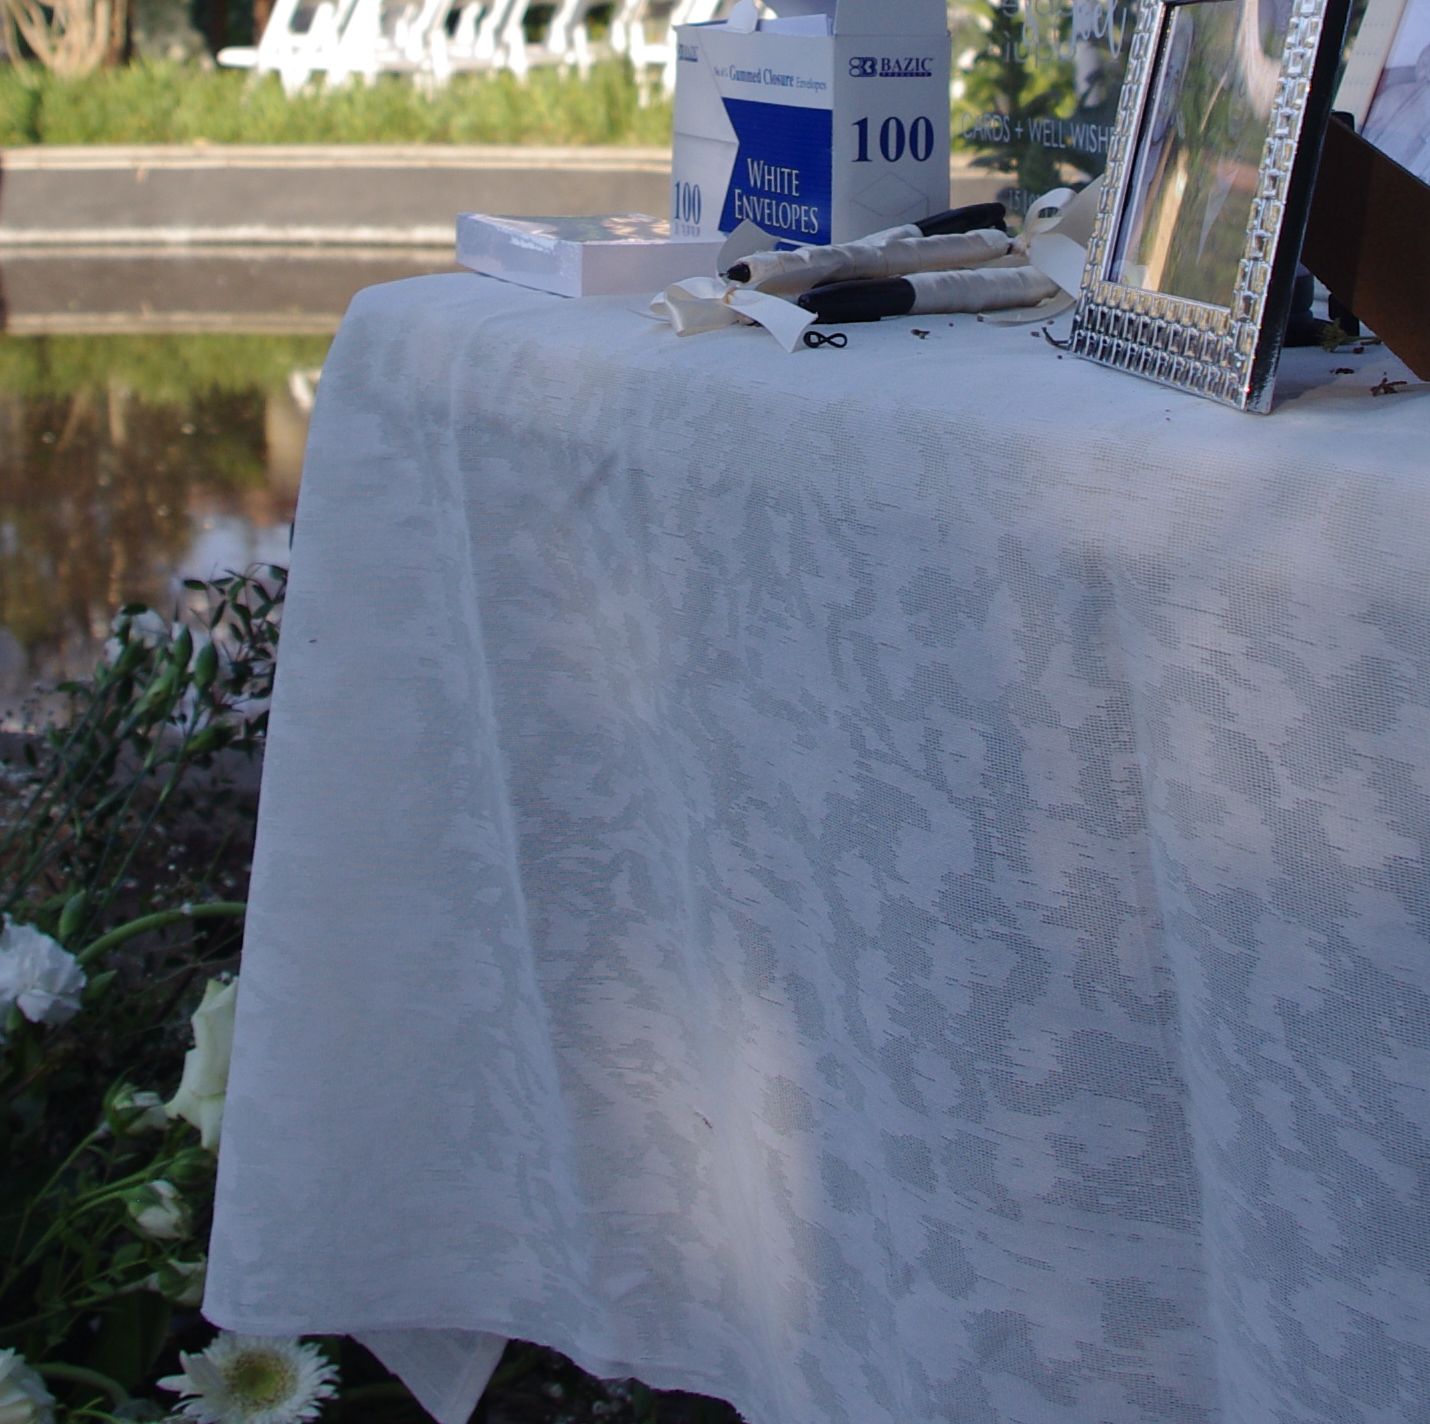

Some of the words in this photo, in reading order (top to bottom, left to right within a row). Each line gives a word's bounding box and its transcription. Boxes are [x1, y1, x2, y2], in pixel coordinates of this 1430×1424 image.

[729, 64, 762, 84] Gummed
[763, 68, 794, 88] Closure
[881, 57, 934, 72] BAZIC
[851, 116, 935, 163] 100
[961, 112, 1011, 143] CARDS
[1014, 121, 1024, 139] +
[1028, 117, 1066, 149] WELL
[747, 158, 800, 197] WHITE
[674, 180, 702, 225] 100
[734, 188, 819, 235] ENVELOPES
